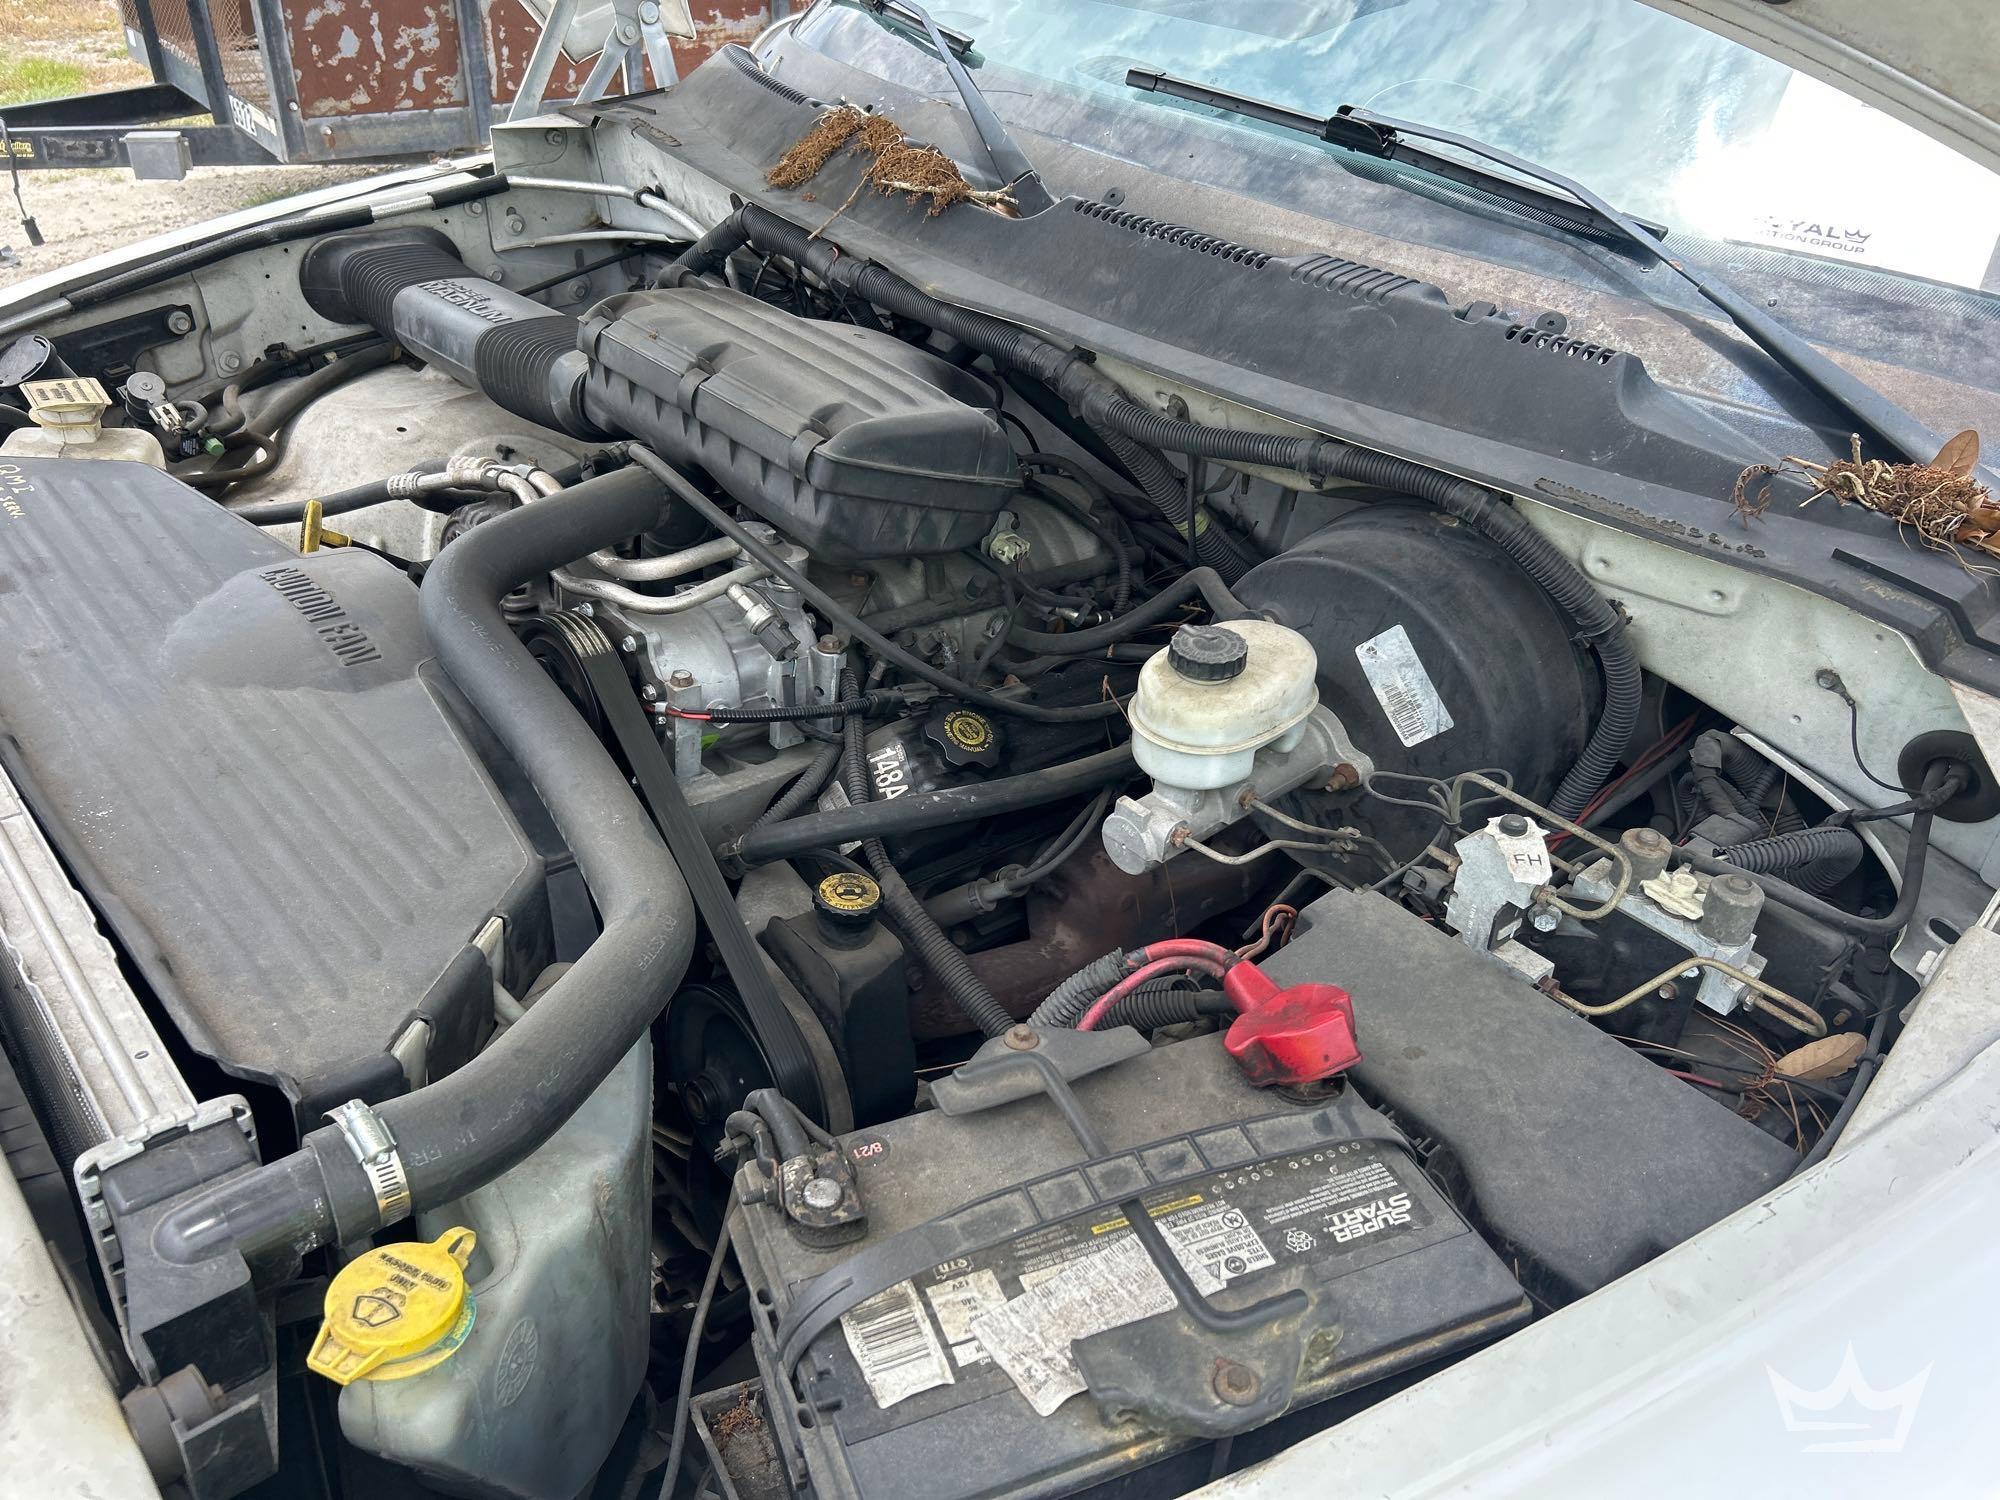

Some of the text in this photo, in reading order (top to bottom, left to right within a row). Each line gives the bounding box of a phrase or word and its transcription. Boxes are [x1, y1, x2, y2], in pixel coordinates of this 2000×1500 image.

[1809, 238, 1865, 253] GROUP
[417, 281, 513, 324] MAGNUM
[259, 568, 382, 668] CAUTION FAN
[959, 742, 986, 753] MANUAL
[867, 746, 909, 800] 148A
[1513, 852, 1543, 867] FH
[853, 1141, 883, 1159] 8/21
[1330, 1193, 1411, 1232] START
[1333, 1209, 1411, 1243] SUPER
[1204, 1238, 1259, 1261] EXPLOSIVE GASES
[1246, 1252, 1269, 1265] SHIELD
[952, 1279, 970, 1291] 12V
